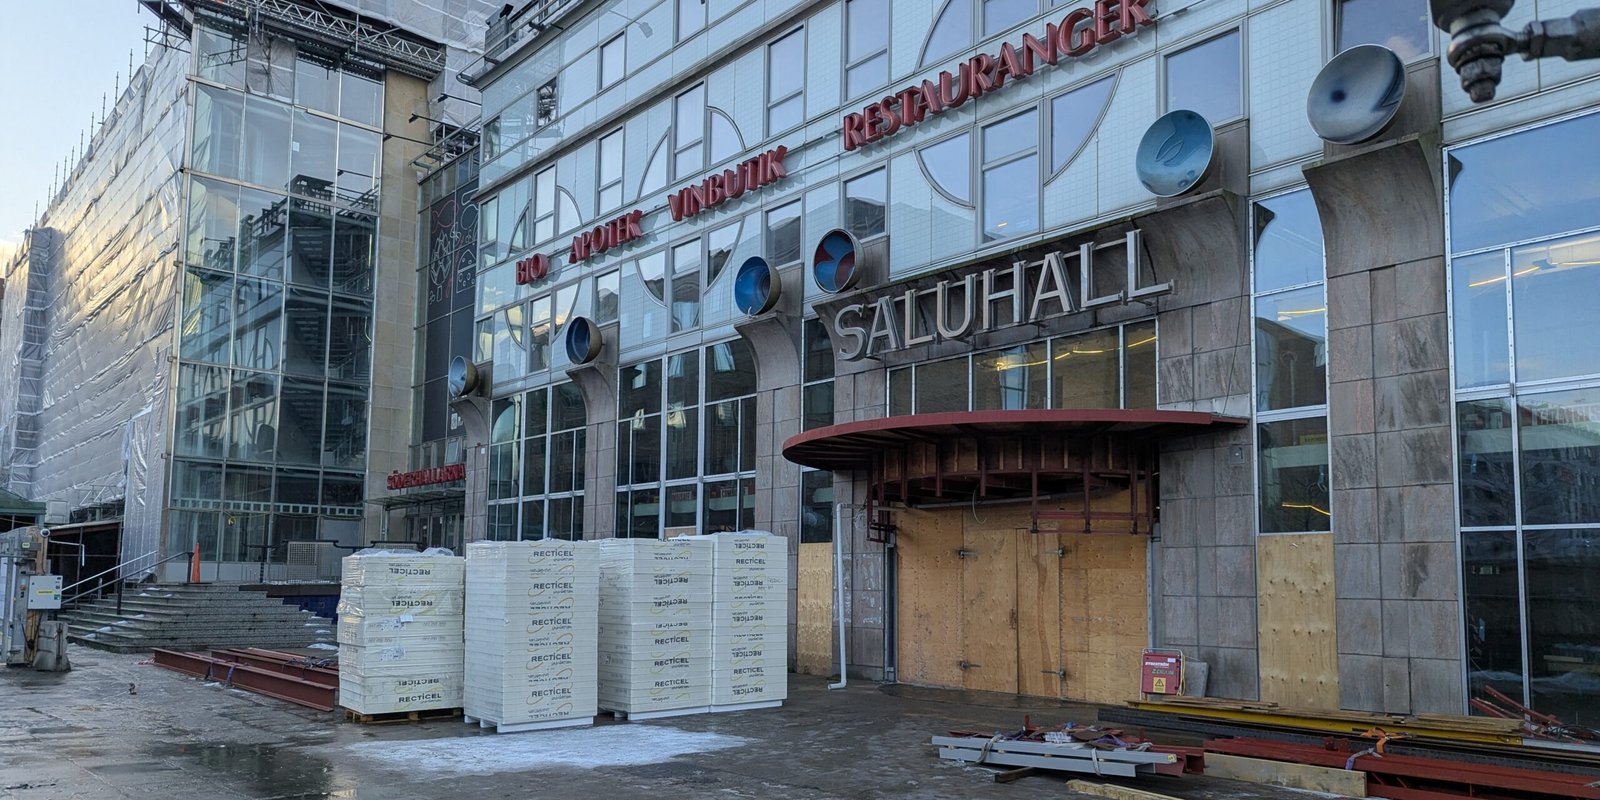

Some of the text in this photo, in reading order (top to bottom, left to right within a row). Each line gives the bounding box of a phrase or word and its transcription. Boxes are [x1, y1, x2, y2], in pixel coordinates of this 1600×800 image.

[516, 0, 1153, 285] BIO APOTEK VINBUTIK RESTAURANGER
[834, 228, 1175, 362] SALUHALL
[387, 463, 467, 490] SÖDERHALLARNA
[533, 548, 574, 557] RECTICEL
[736, 556, 766, 565] RECTICEL
[533, 580, 574, 590] RECTICEL
[531, 616, 572, 626] RECTICEL
[654, 635, 689, 645] RECTICEL
[531, 652, 572, 663] RECTICEL
[654, 656, 690, 667] RECTICEL
[733, 666, 764, 675] RECTICEL
[654, 678, 689, 688] RECTICEL
[531, 686, 572, 698] RECTICEL
[398, 692, 442, 703] RECTICEL
